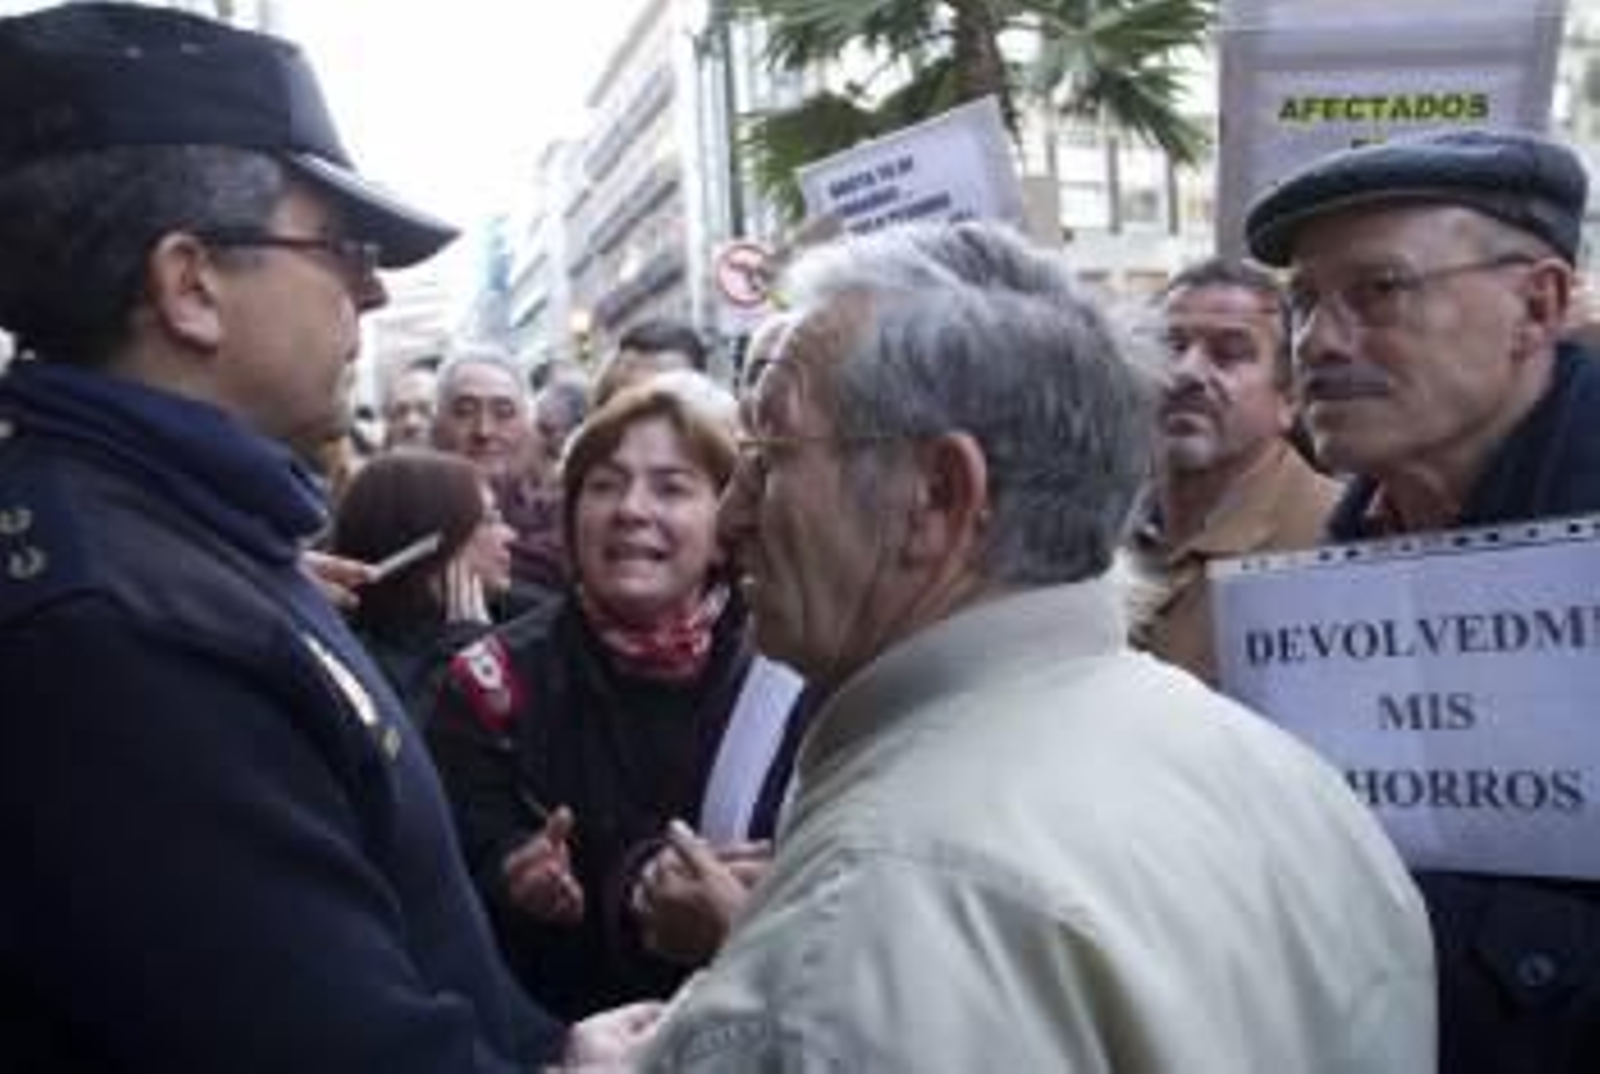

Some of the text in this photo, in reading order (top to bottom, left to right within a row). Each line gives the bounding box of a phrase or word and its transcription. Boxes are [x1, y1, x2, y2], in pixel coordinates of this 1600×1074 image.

[1278, 93, 1490, 122] AFECTADOS
[1378, 692, 1475, 731] MIS
[1344, 767, 1584, 810] HORROS
